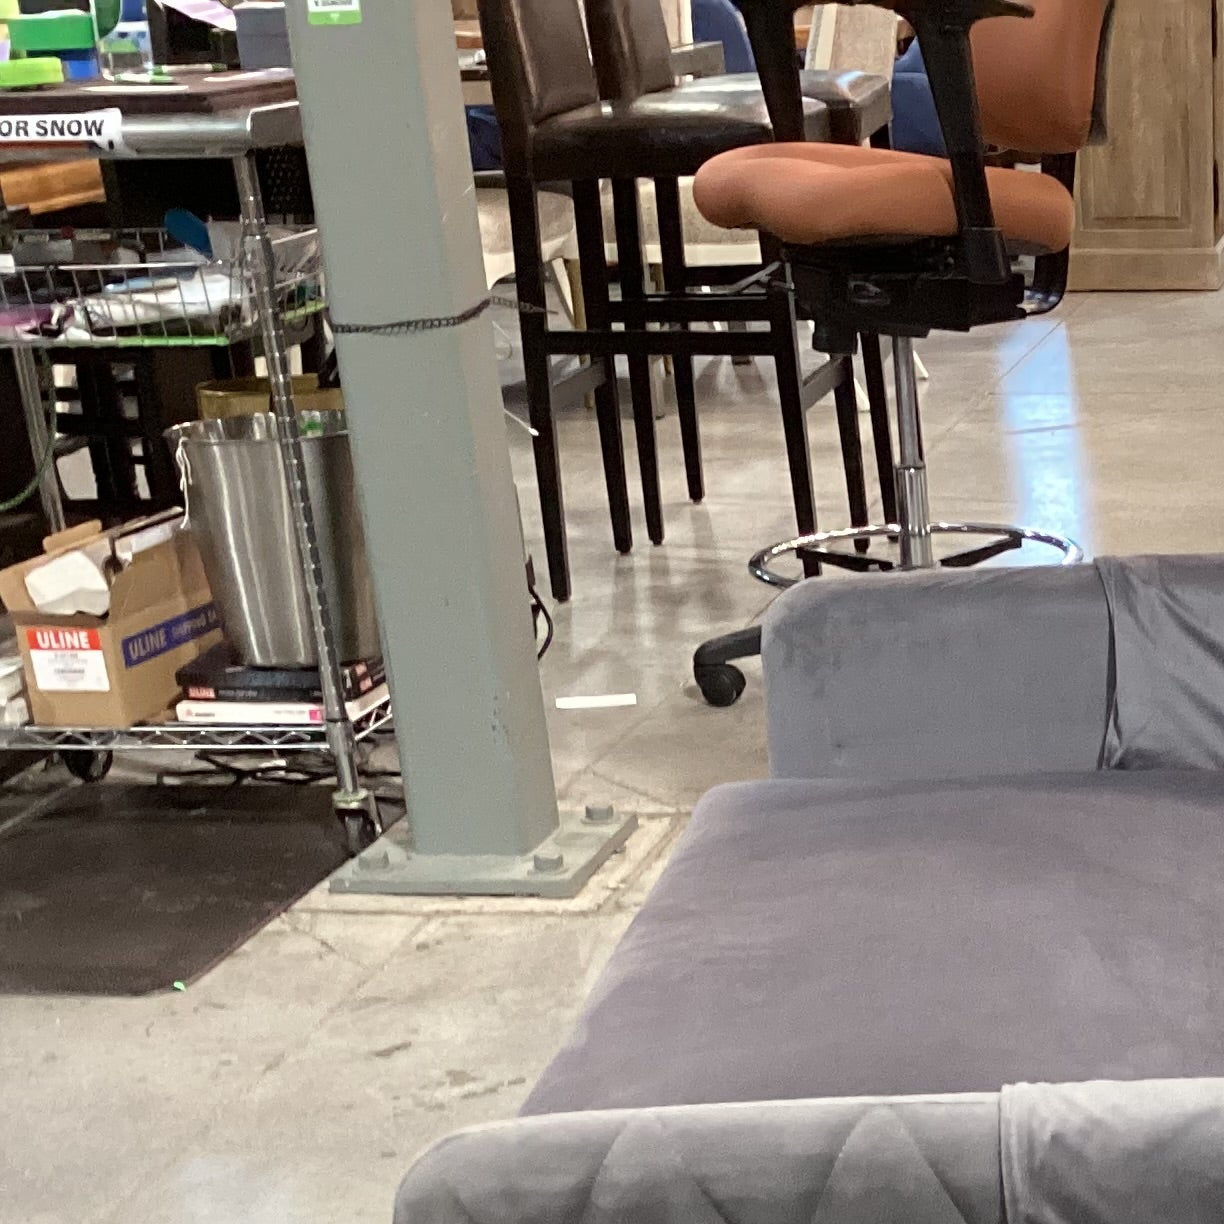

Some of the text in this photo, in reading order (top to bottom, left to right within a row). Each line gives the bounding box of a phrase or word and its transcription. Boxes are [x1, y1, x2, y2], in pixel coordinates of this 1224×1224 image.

[35, 119, 104, 136] SNOW
[36, 630, 91, 649] ULINE
[128, 627, 167, 660] ULINE
